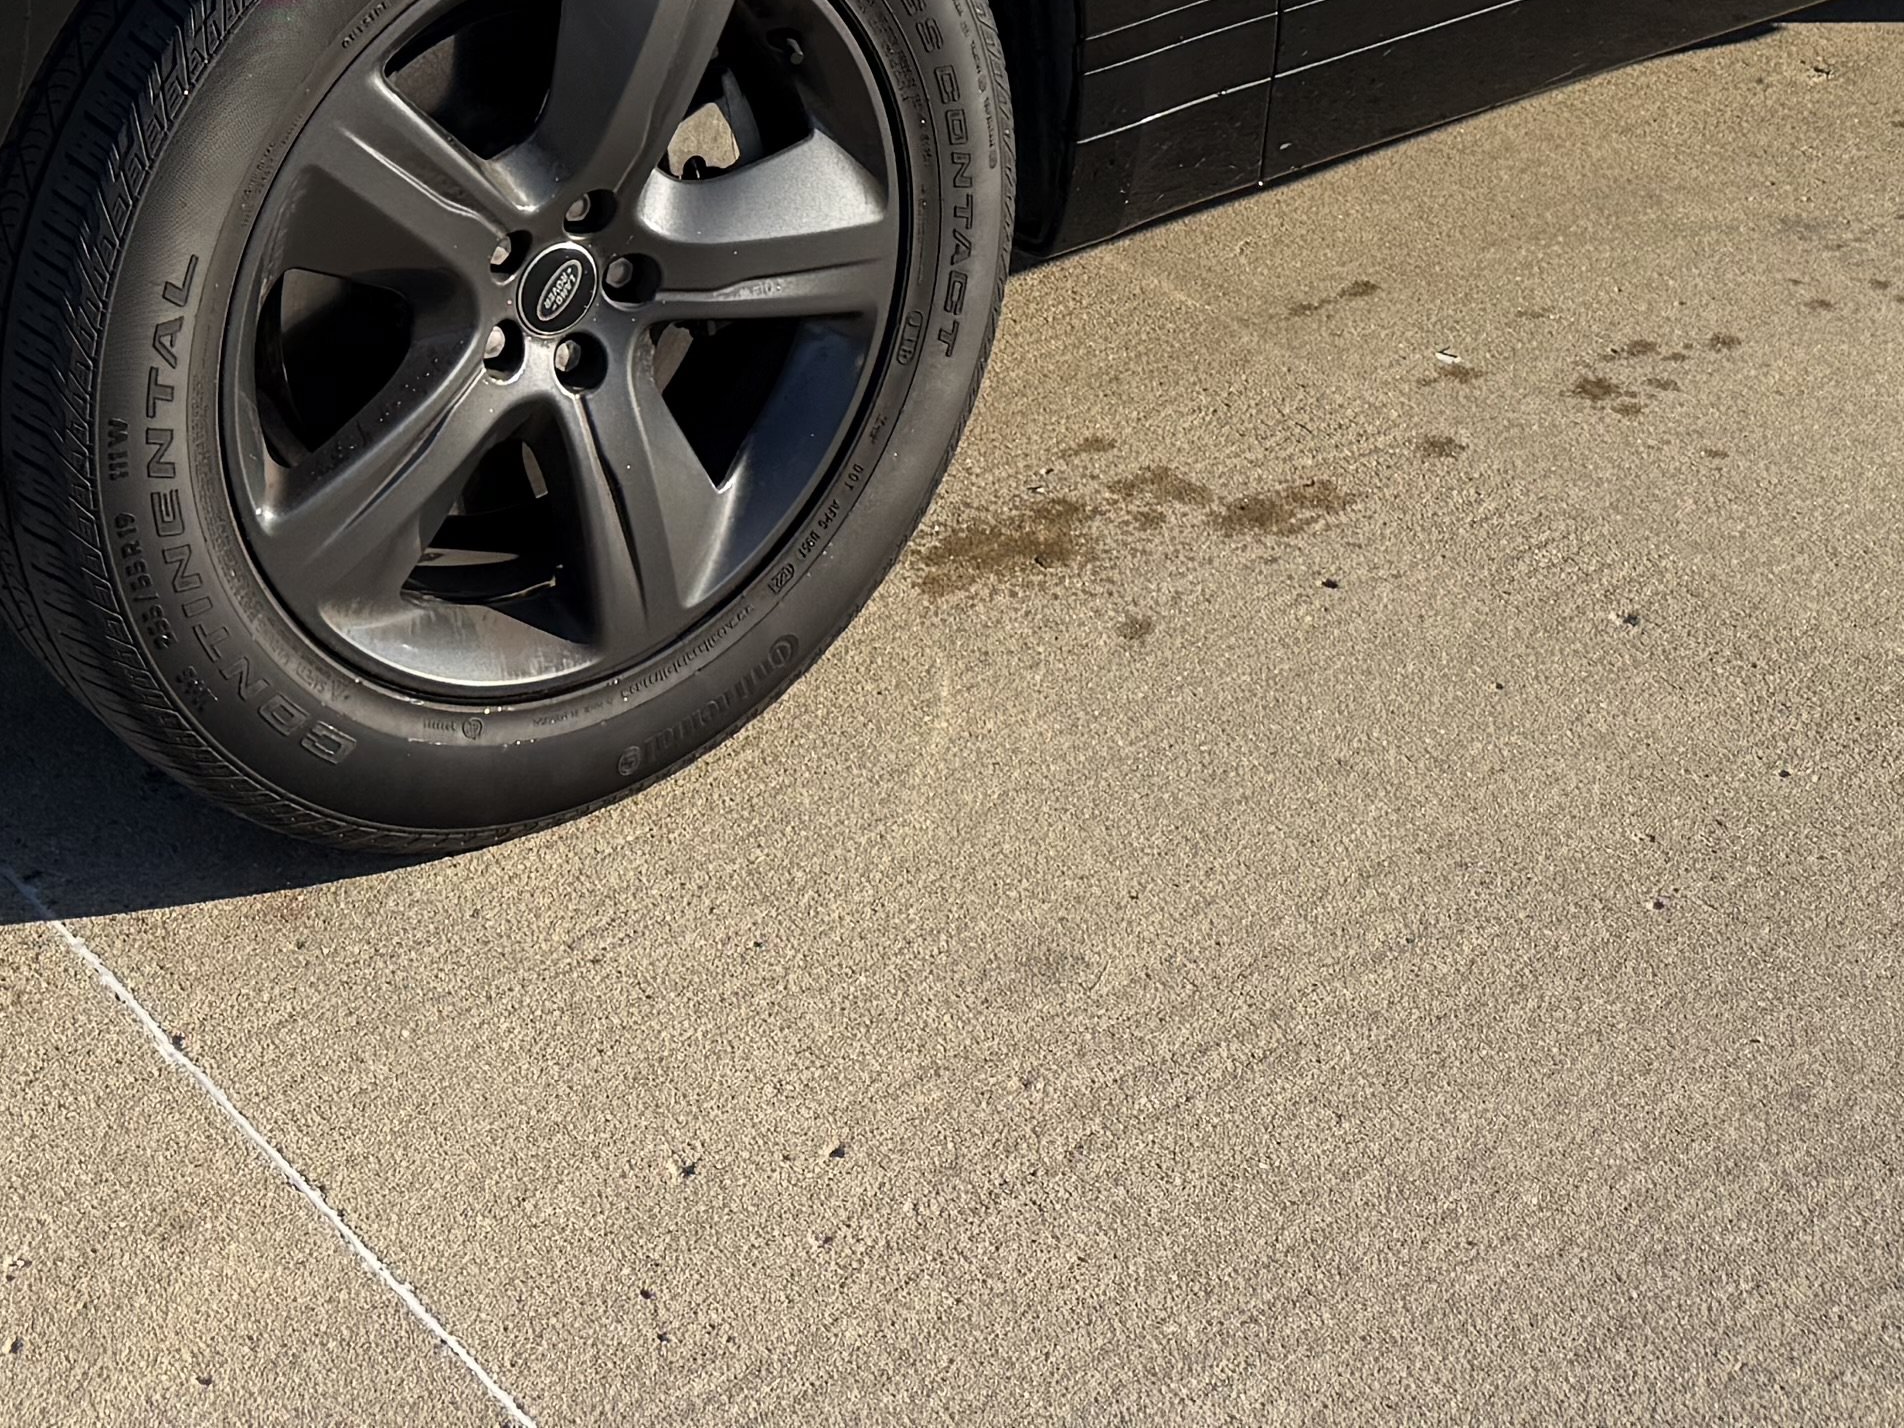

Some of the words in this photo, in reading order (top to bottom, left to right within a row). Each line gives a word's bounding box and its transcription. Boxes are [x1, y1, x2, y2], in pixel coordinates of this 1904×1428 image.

[933, 64, 974, 358] CONTACT
[543, 271, 569, 310] ROVER
[555, 273, 576, 306] LAND
[845, 463, 865, 491] DOT
[146, 254, 357, 765] CONTINENTAL
